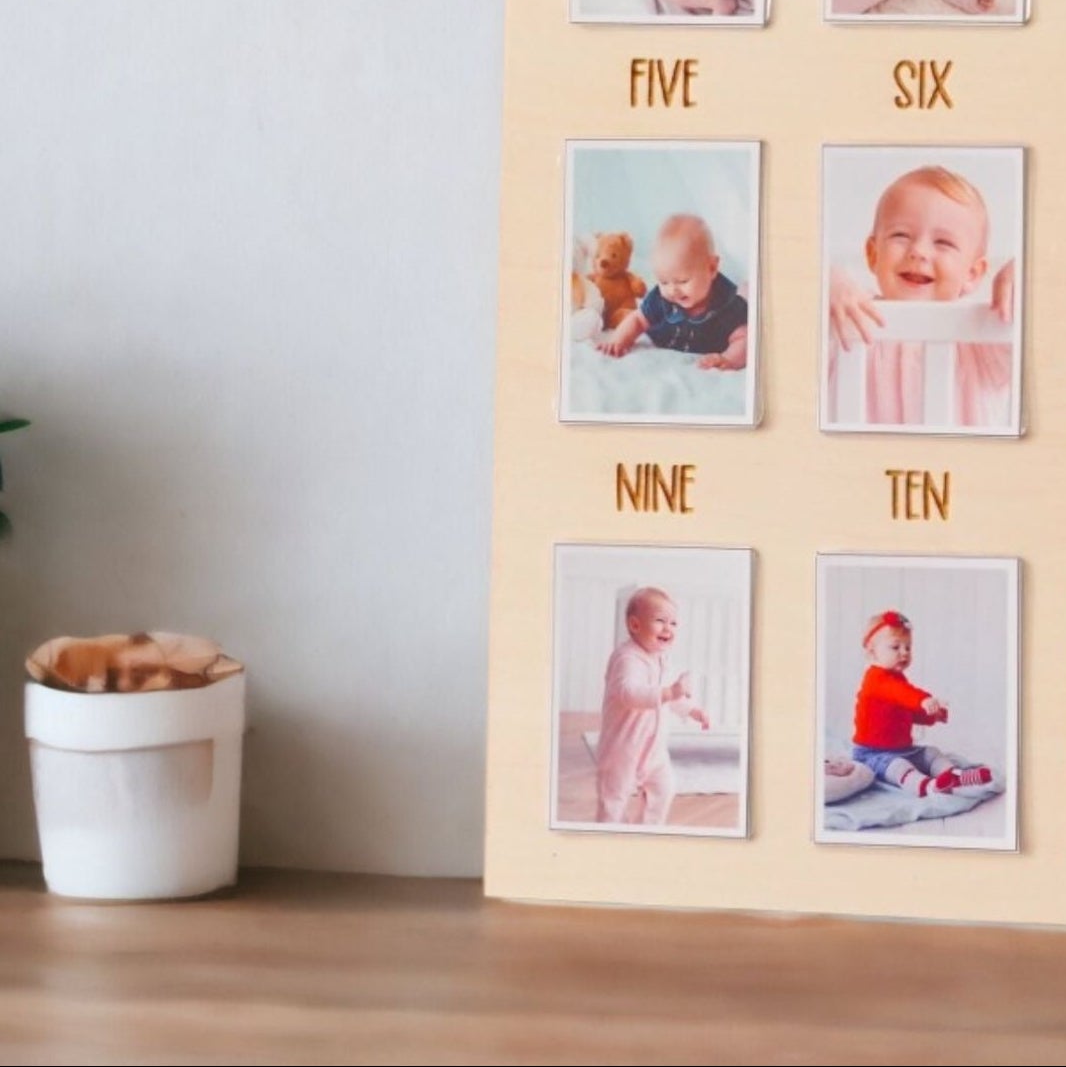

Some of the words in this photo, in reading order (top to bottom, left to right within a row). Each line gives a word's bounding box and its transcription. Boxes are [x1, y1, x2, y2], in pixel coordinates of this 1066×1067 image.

[629, 57, 699, 109] FIVE
[892, 59, 953, 110] SIX
[615, 462, 696, 515] NINE
[884, 469, 951, 522] TEN
